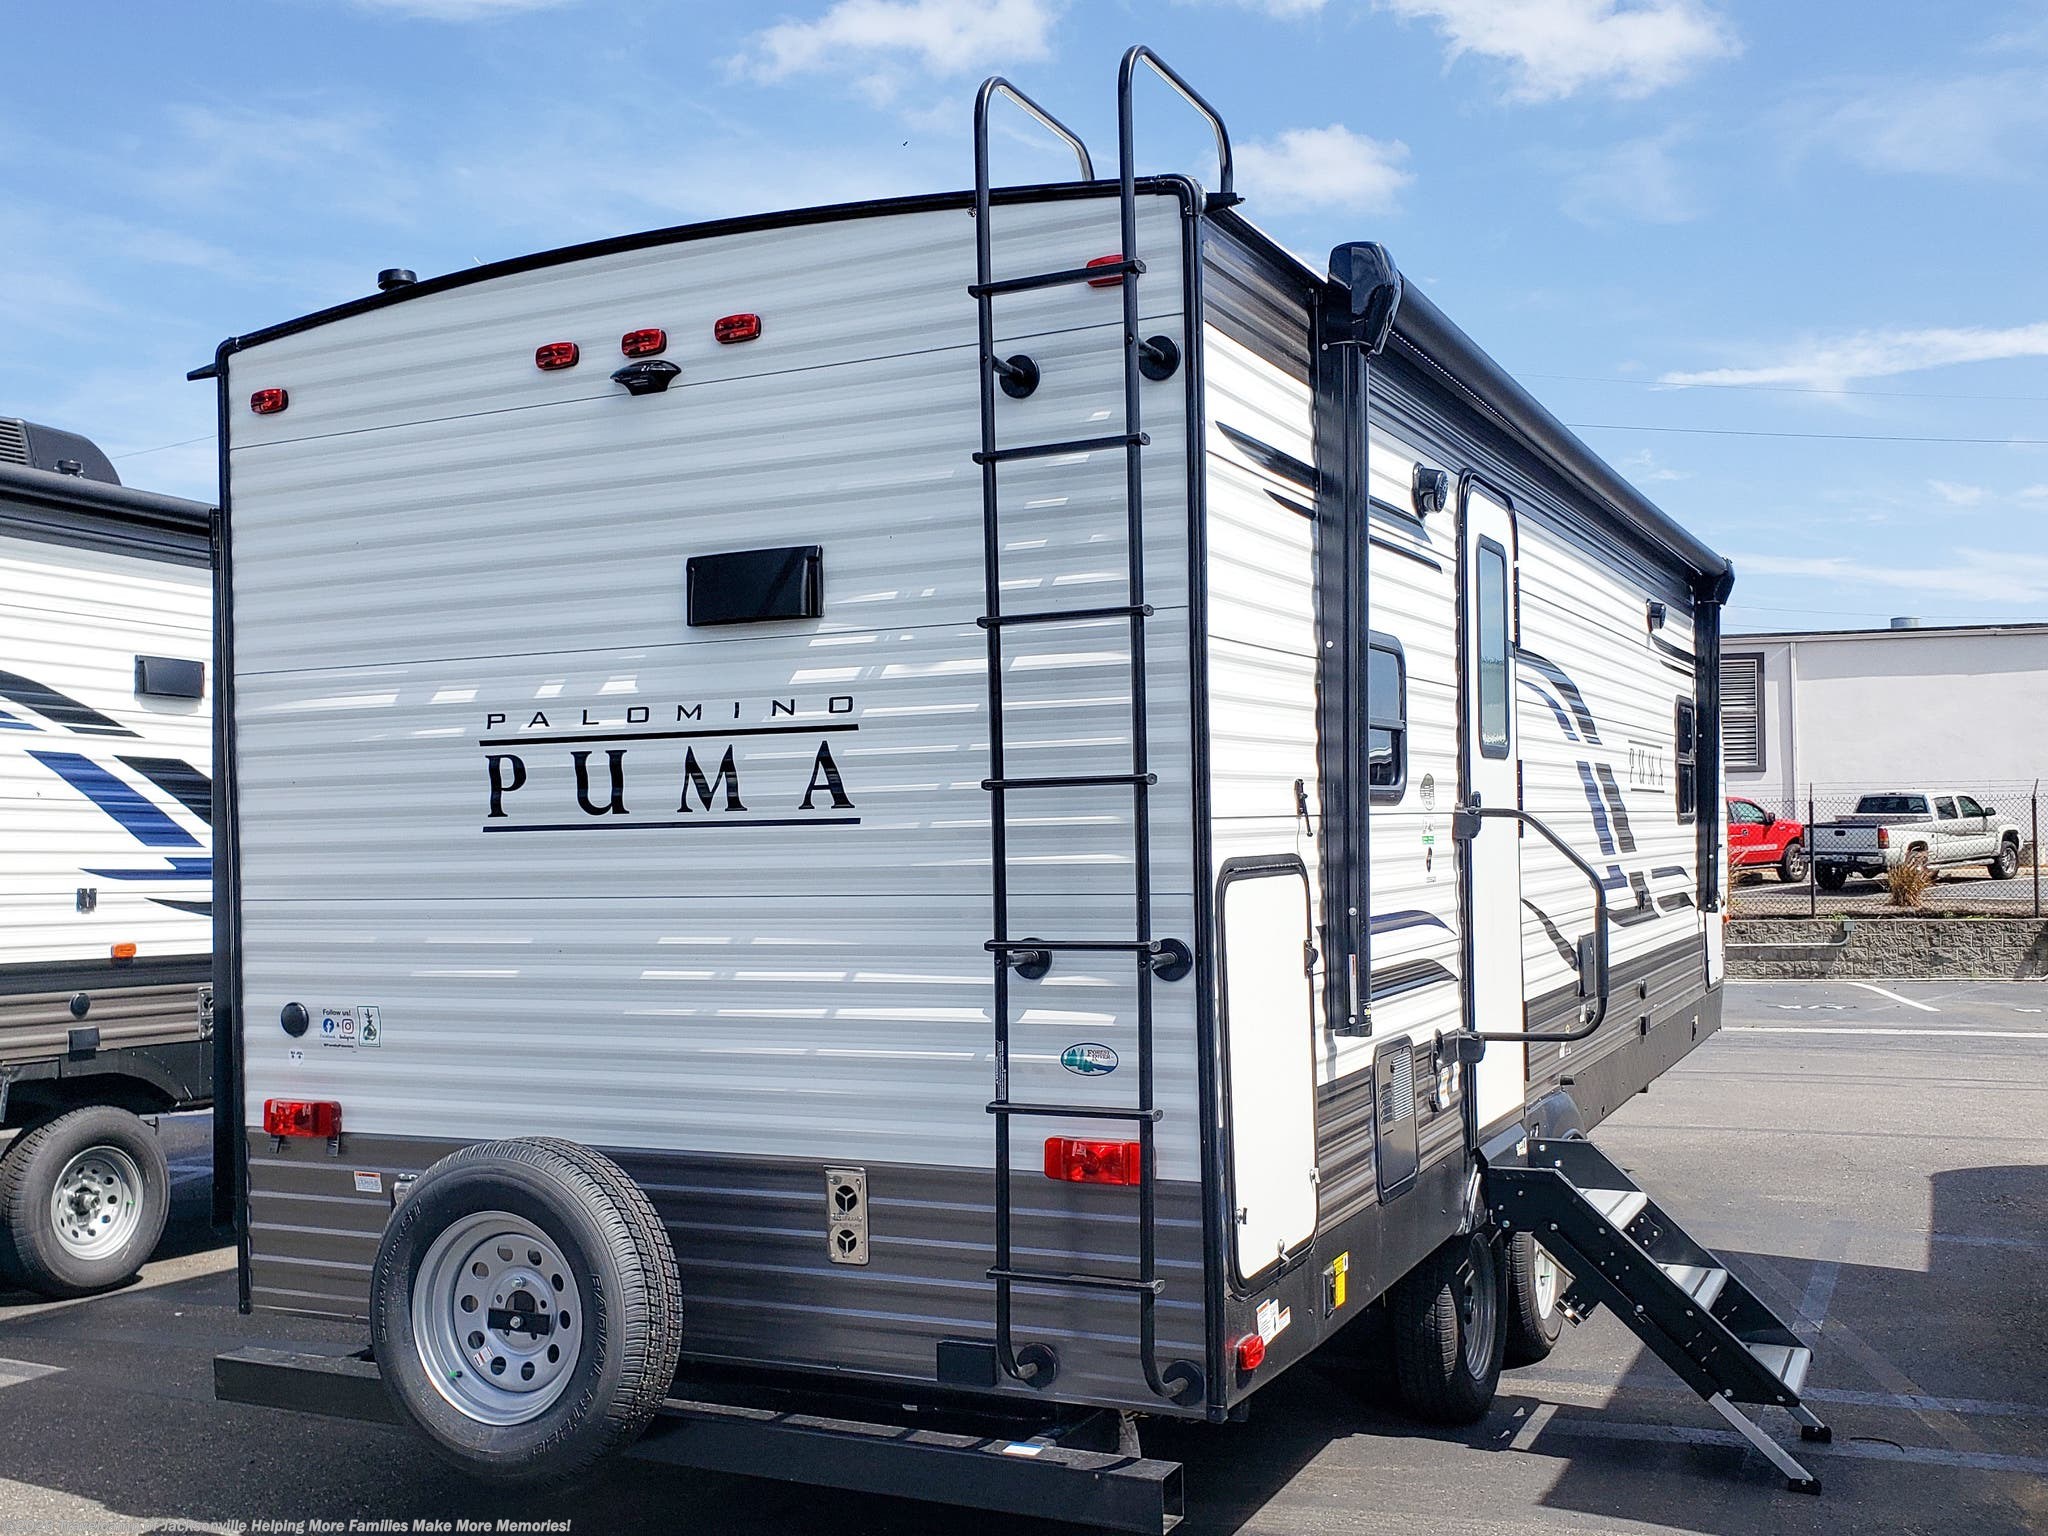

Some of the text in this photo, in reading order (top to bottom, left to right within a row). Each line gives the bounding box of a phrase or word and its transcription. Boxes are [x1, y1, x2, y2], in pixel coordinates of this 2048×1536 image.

[486, 696, 854, 729] PALOMINO
[485, 741, 856, 818] PUMA
[1629, 748, 1664, 786] PUMA
